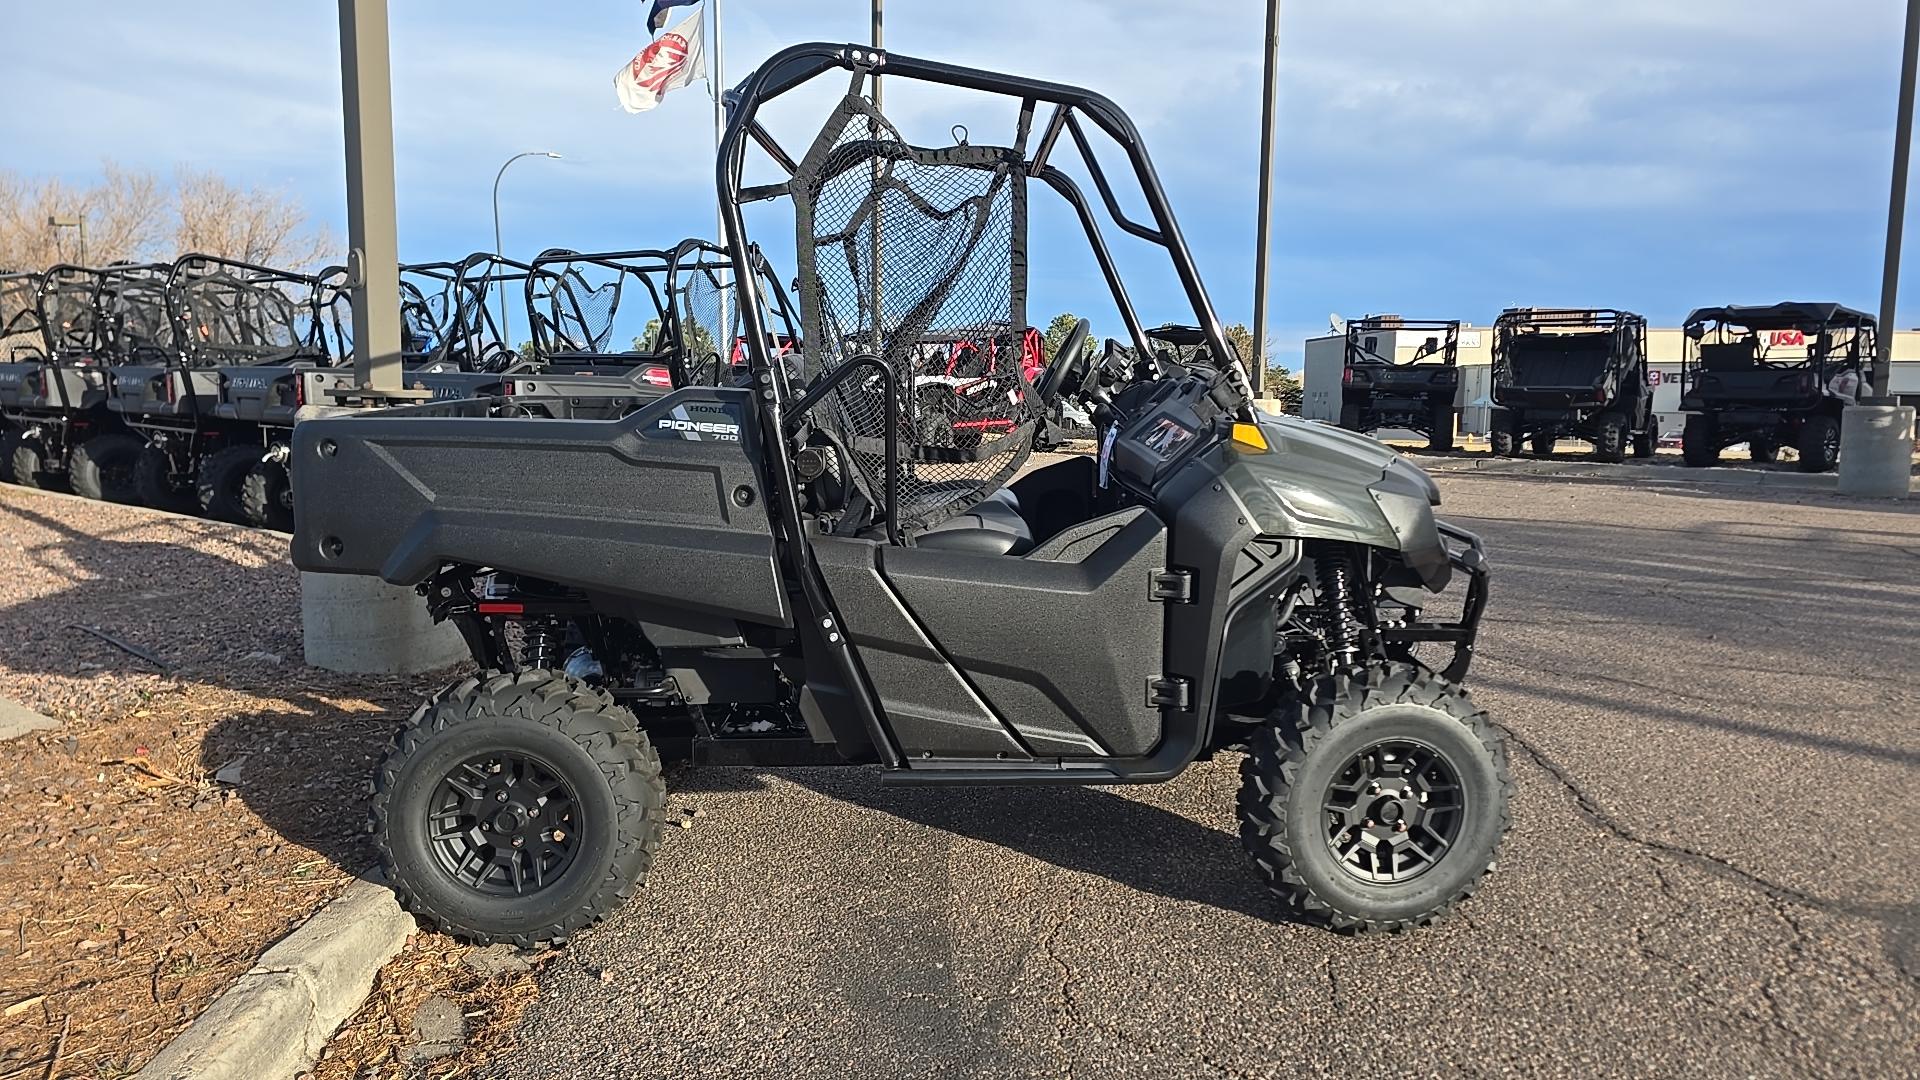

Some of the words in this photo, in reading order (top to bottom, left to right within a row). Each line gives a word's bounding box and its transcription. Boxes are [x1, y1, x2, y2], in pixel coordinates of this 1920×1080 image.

[1770, 332, 1805, 346] USA
[1661, 373, 1693, 383] VEE
[690, 405, 729, 414] HOND
[658, 419, 740, 435] PIONEER
[711, 433, 739, 442] 700
